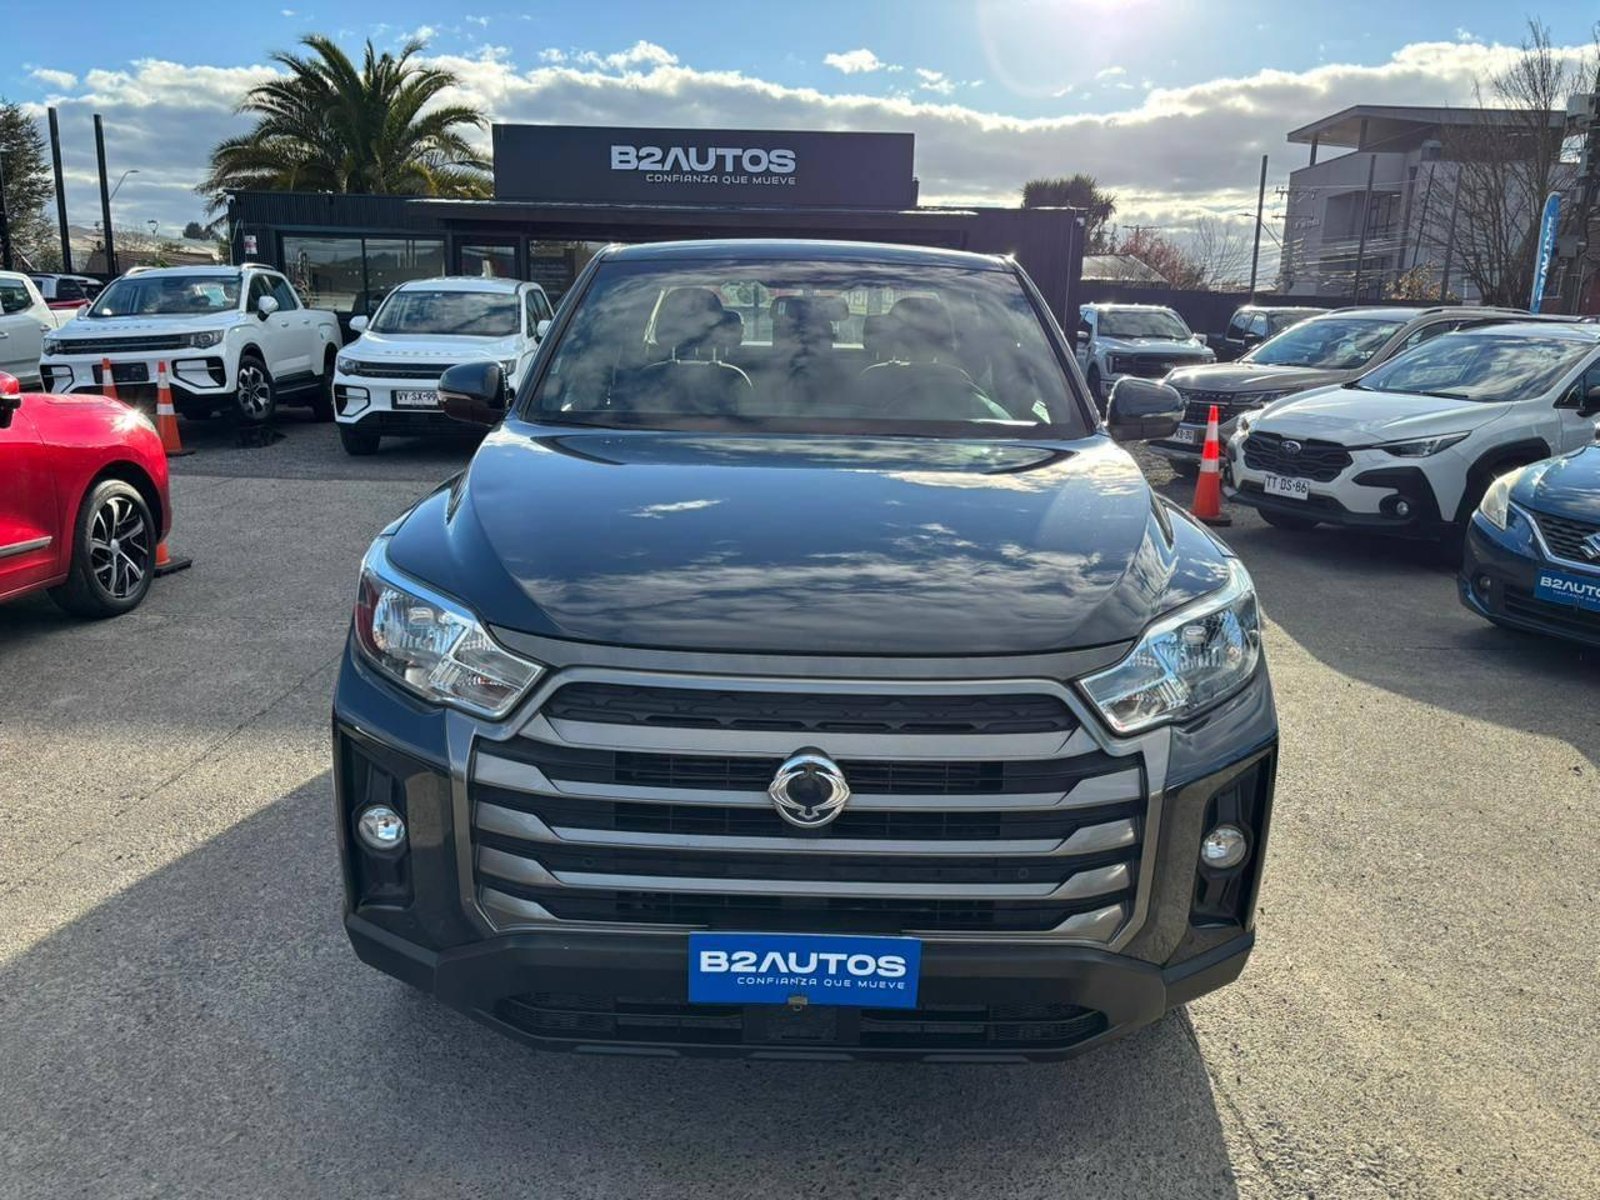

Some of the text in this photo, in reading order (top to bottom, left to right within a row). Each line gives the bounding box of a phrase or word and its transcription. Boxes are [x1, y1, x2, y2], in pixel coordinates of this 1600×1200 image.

[610, 145, 796, 173] B2AUTOS
[645, 173, 796, 186] CONFIANZA QUE MUEVE
[700, 950, 907, 978] B2AUTOS
[736, 977, 906, 990] CONFIANZA QUE MUEVE
